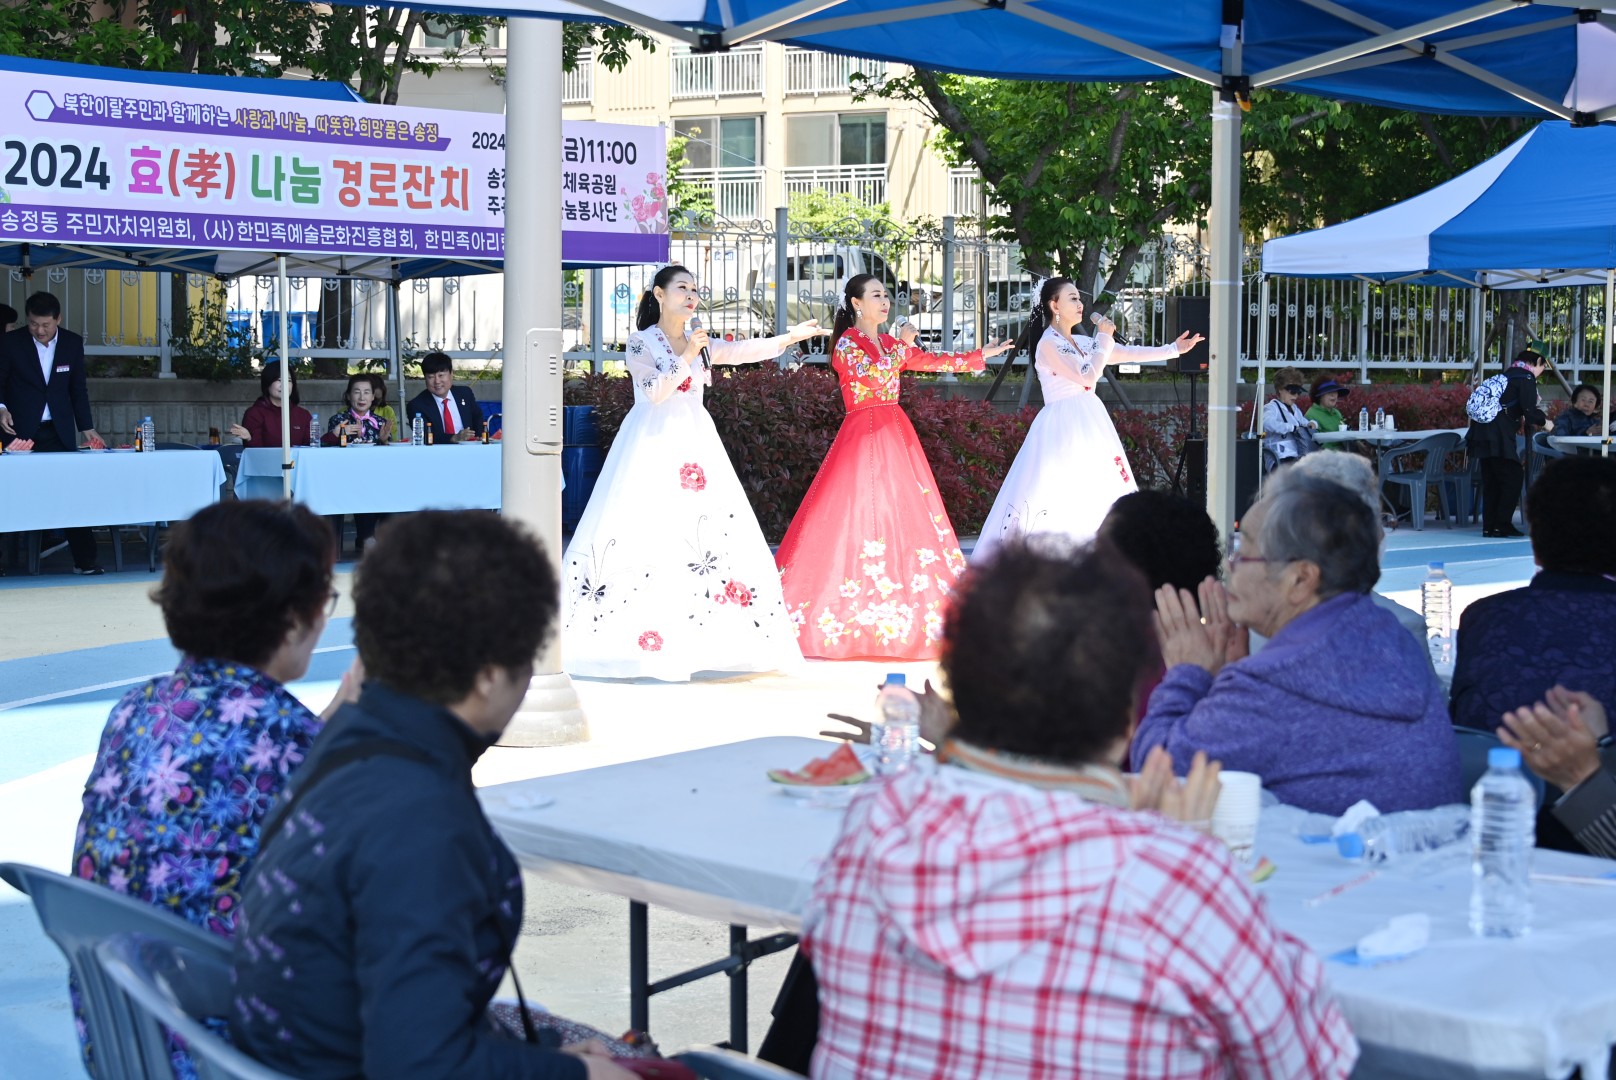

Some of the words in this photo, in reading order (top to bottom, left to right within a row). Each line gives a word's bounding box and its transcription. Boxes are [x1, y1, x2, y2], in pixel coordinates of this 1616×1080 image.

[64, 93, 168, 122] 북한이탈주민과
[171, 101, 229, 127] 함께하는
[234, 108, 275, 131] 사랑과
[280, 112, 312, 135] 나눔,
[315, 115, 355, 137] 따뜻한
[359, 118, 409, 141] 희망품은
[414, 123, 438, 143] 송정
[5, 141, 110, 190] 2024
[128, 145, 236, 200] 효(孝)
[251, 154, 321, 204] 나눔
[332, 159, 469, 212] 경로잔치
[1, 209, 59, 233] 송정동
[66, 212, 196, 241] 주민자치위원회,
[561, 199, 618, 222] 눔봉사단
